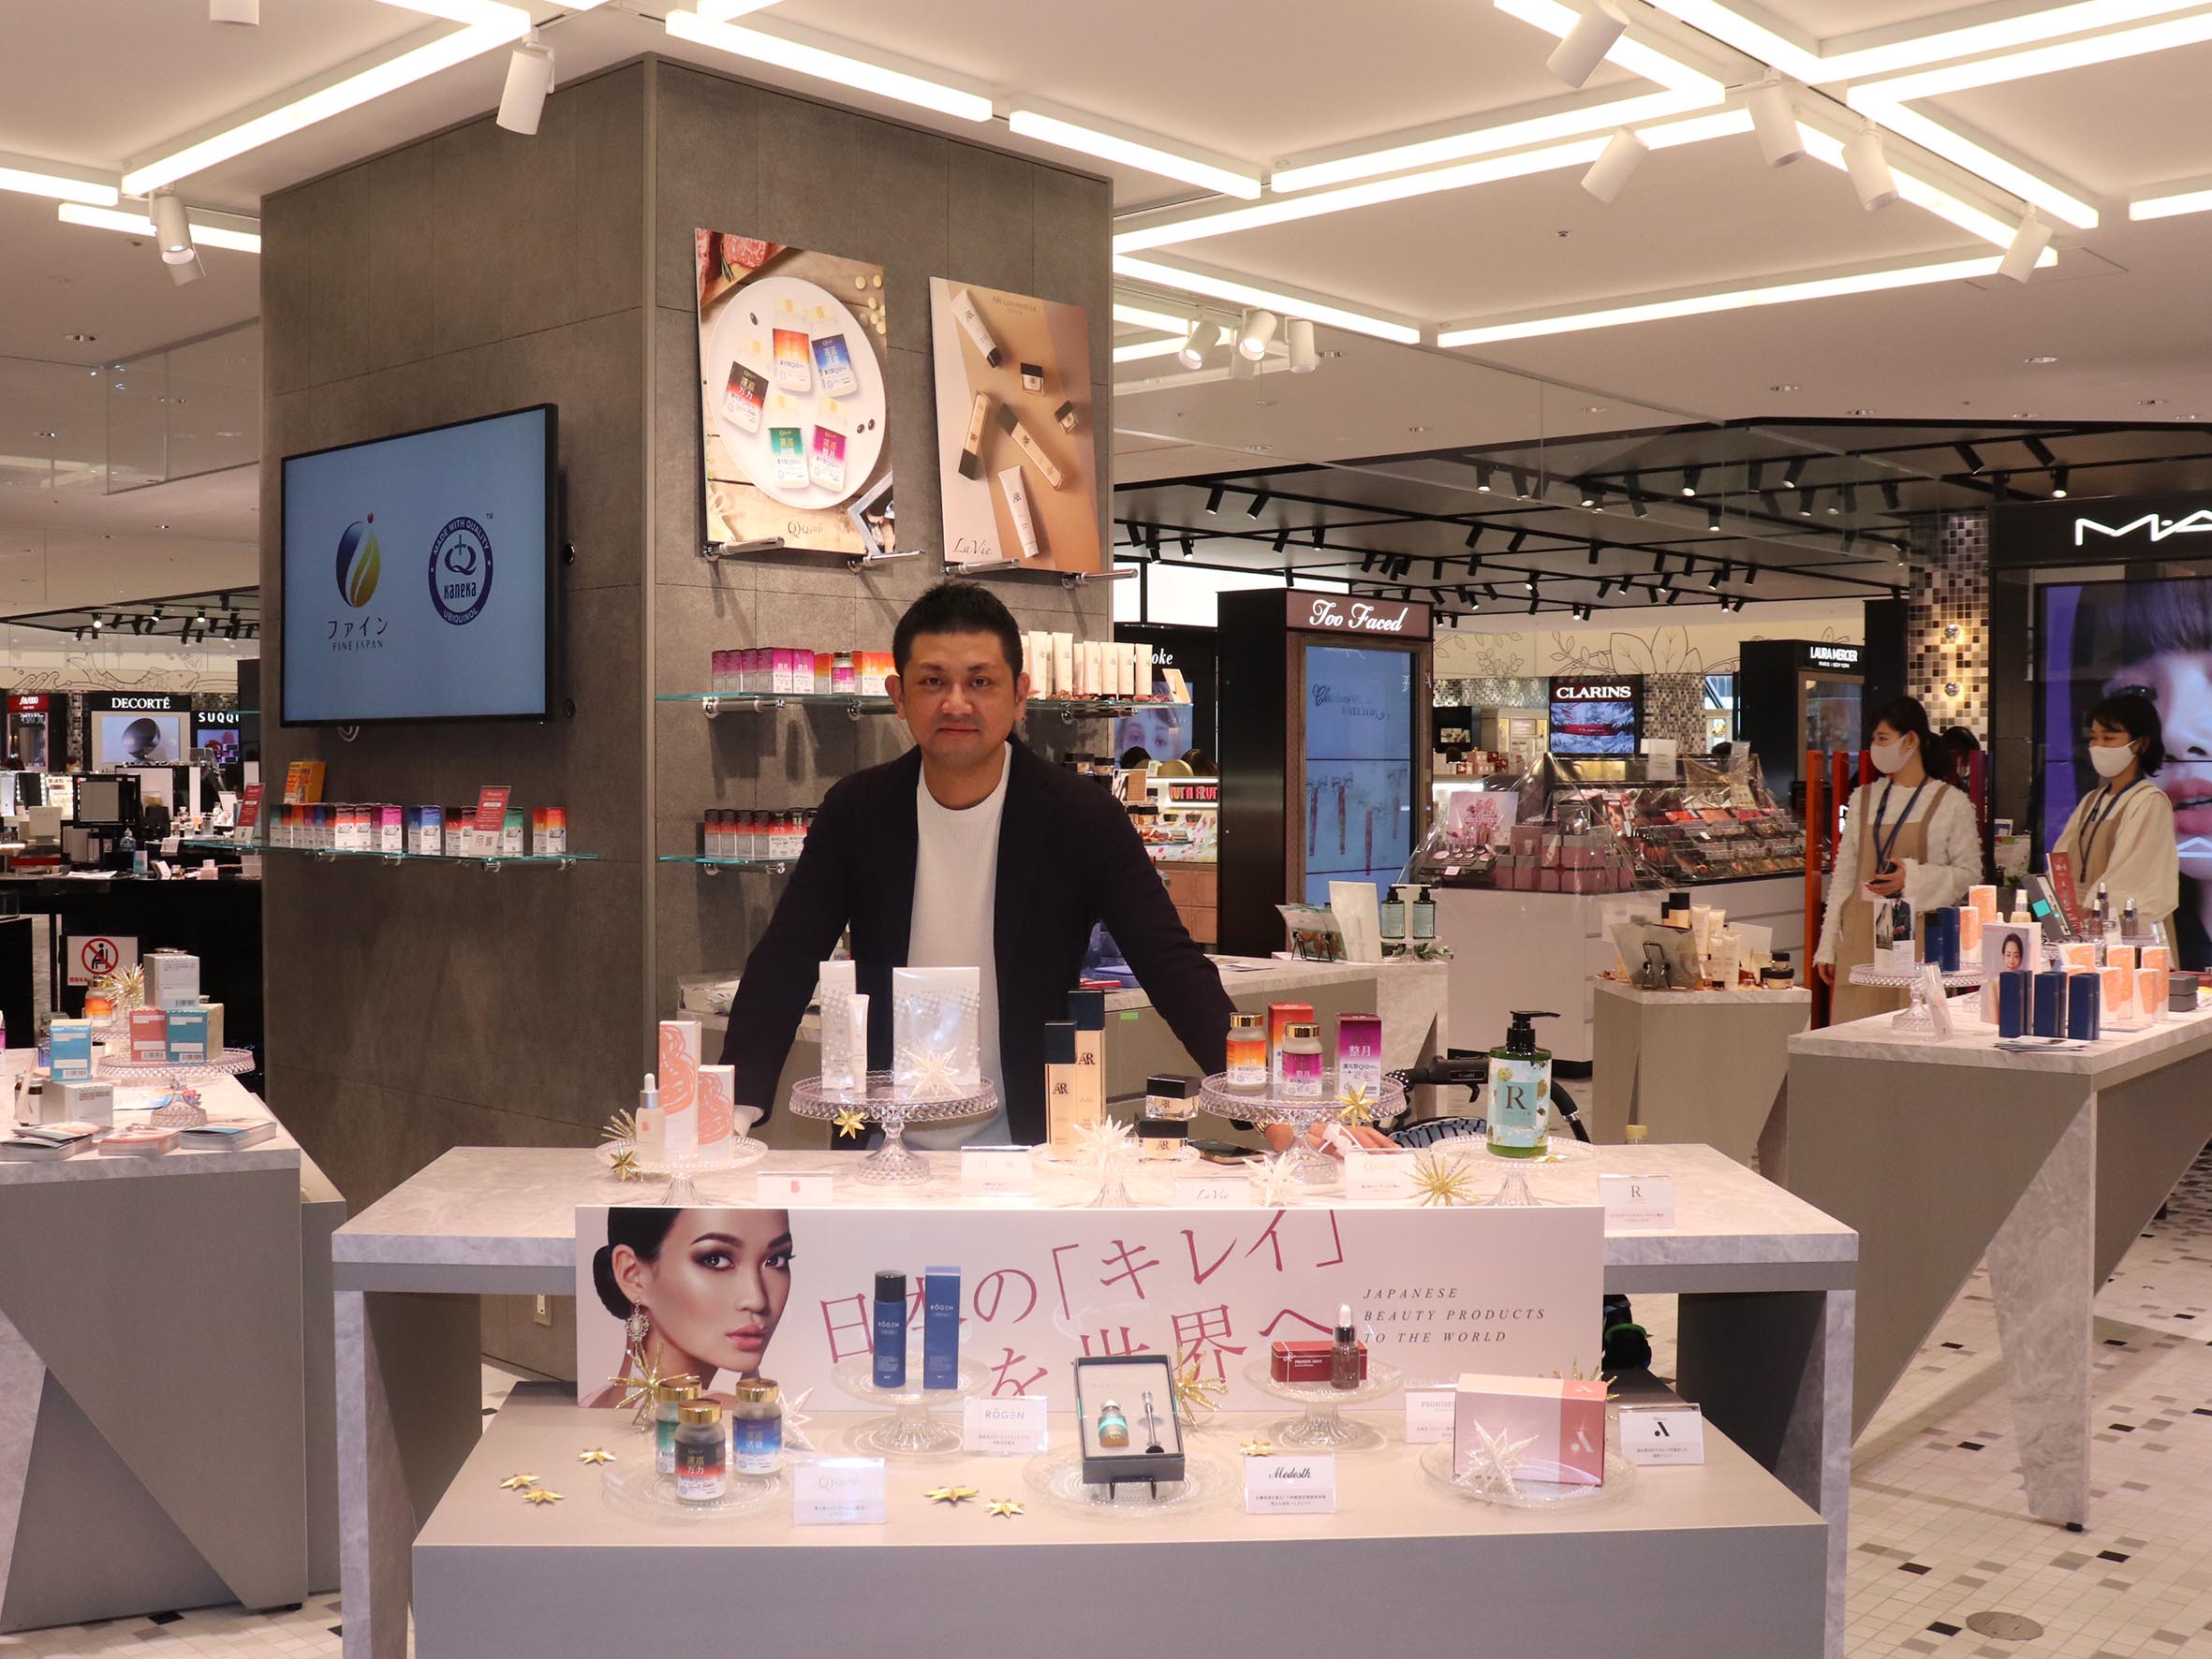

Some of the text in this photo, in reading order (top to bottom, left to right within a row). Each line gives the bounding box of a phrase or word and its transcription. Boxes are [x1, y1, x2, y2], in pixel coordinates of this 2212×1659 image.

[443, 608, 479, 624] UBIQUINOL
[1308, 598, 1409, 632] Too Faced
[328, 615, 389, 640] ファイン
[356, 639, 383, 652] JAPAN
[1556, 685, 1632, 699] CLARINS
[111, 696, 170, 710] DECORTÉ
[198, 712, 240, 723] SUQQ
[1349, 1045, 1372, 1057] 整月
[1505, 1085, 1527, 1110] R
[1630, 1184, 1642, 1198] R
[1363, 1287, 1459, 1299] JAPANESE
[1364, 1308, 1546, 1322] BEAUTY PRODUCTS
[1363, 1330, 1508, 1344] TO THE WORLD
